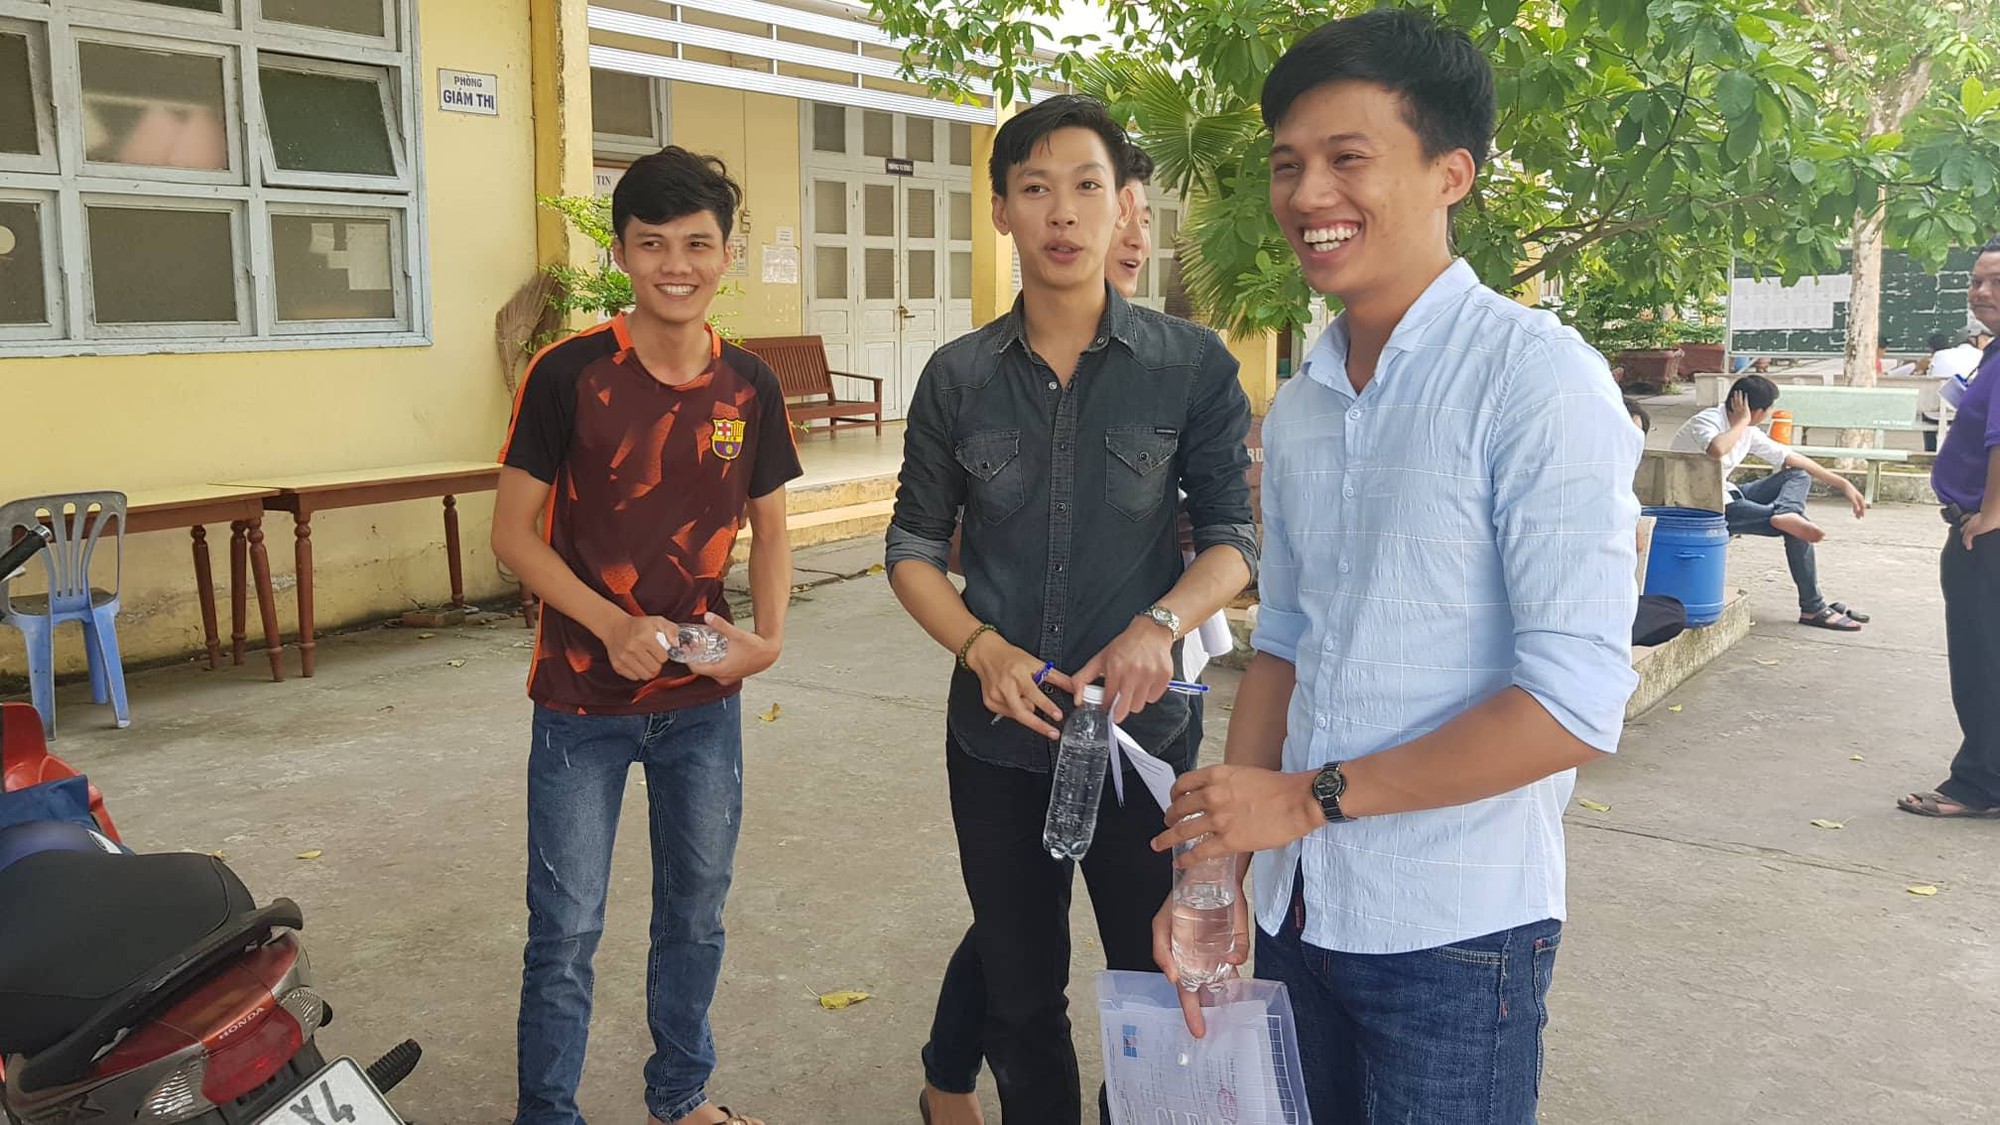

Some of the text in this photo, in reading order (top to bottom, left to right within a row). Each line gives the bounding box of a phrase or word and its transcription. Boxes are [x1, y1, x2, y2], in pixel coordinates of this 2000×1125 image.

[454, 74, 482, 88] PHÒNG
[443, 87, 494, 110] GIÁM THỊ
[596, 174, 612, 186] TIN
[219, 1007, 264, 1039] HONDA
